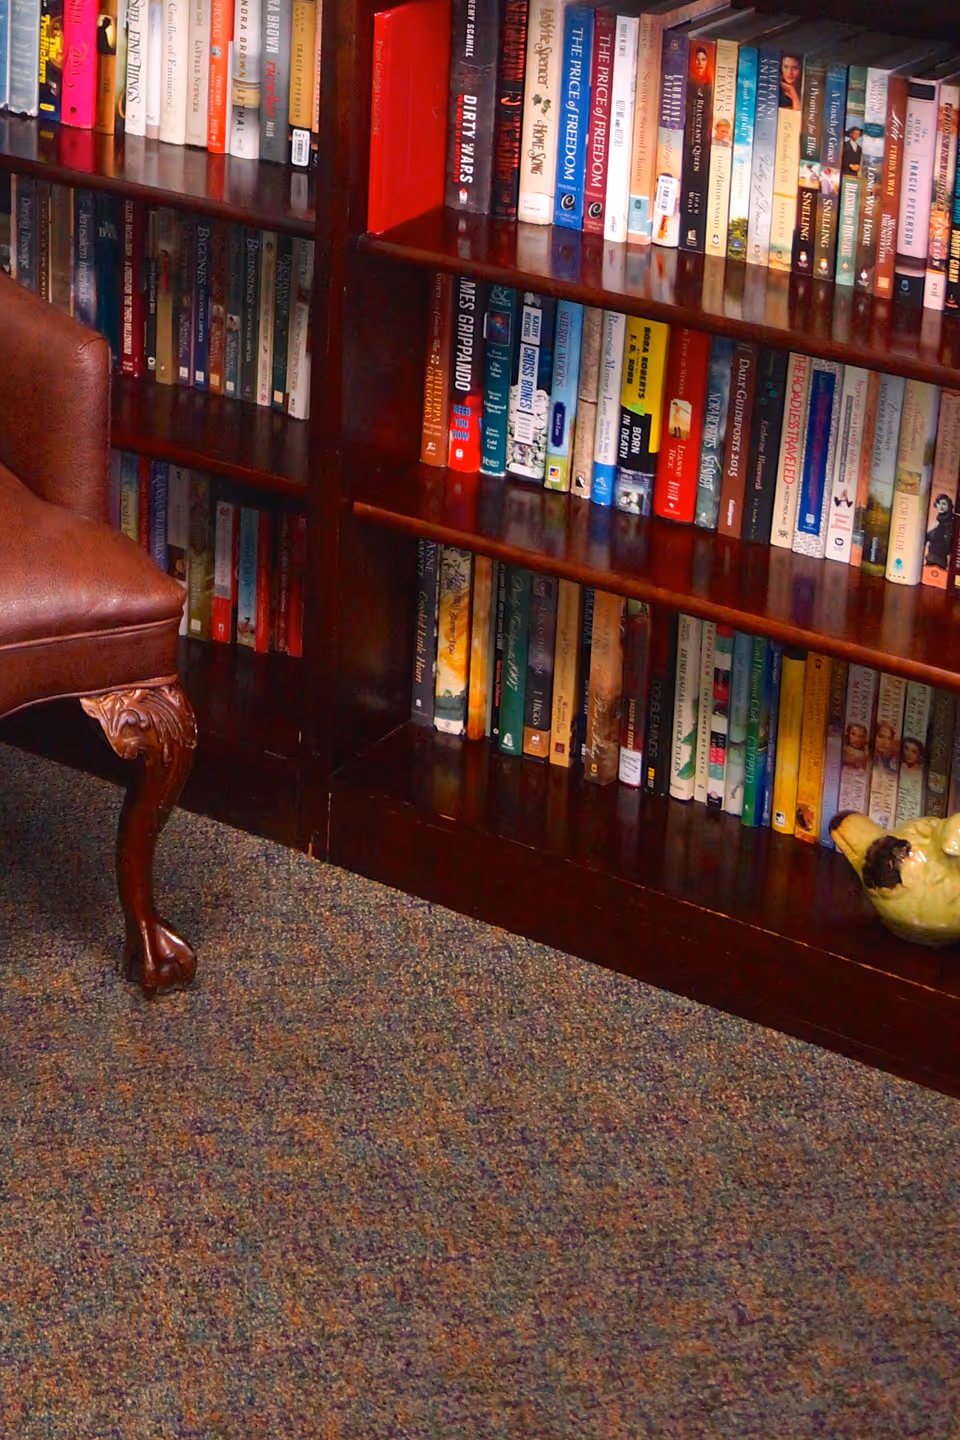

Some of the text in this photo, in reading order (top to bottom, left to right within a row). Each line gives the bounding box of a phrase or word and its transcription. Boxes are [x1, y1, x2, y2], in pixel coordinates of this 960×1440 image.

[39, 15, 50, 83] Traffickers
[49, 37, 59, 58] The
[239, 37, 247, 78] BROWN
[267, 15, 279, 53] BROWN
[465, 24, 475, 57] SCAHILL
[237, 89, 246, 132] LETHAL
[564, 28, 584, 180] THE PRICE of FREEDOM
[461, 95, 477, 183] DIRTY WARS
[821, 89, 840, 247] A Touch of Grace SNELLING
[197, 225, 209, 285] BYGONES
[455, 314, 477, 391] GRIPPANDO
[520, 347, 536, 409] CROSS BONES
[619, 415, 631, 458] IN DEATH
[631, 426, 642, 453] BORN
[728, 358, 749, 477] DAILY GUIDEPOSTS 2015
[415, 630, 426, 683] Little Heart
